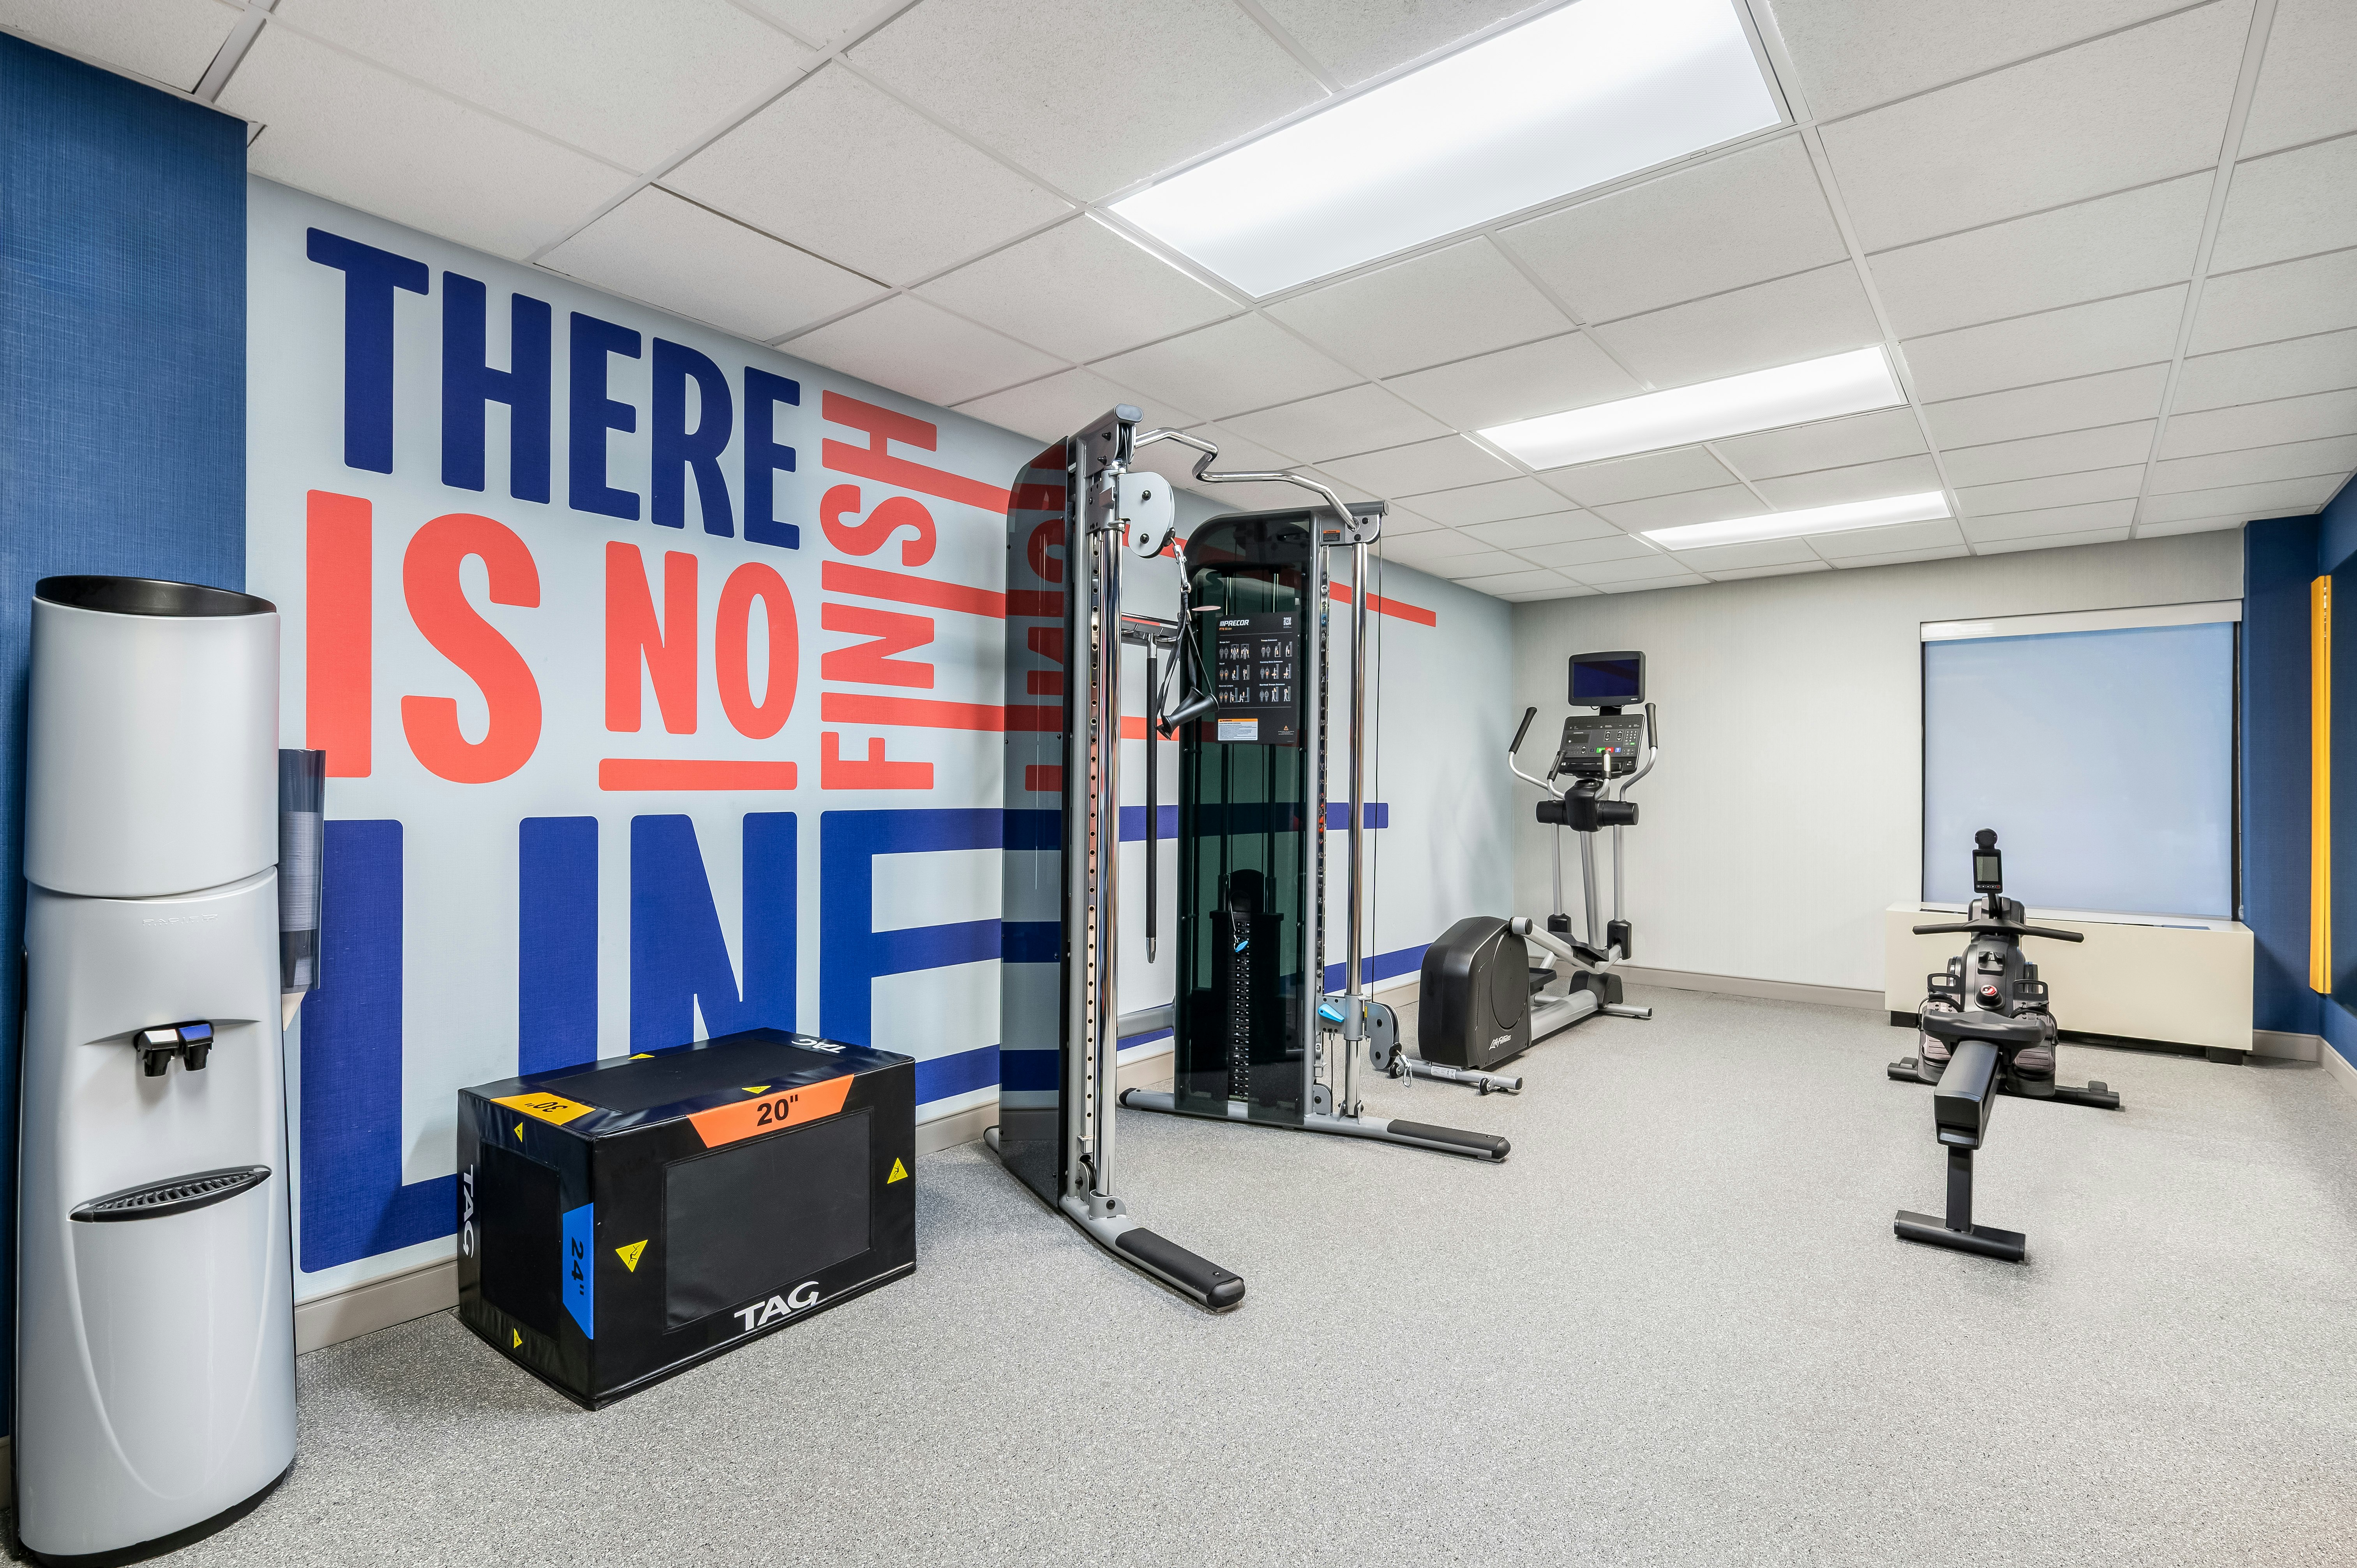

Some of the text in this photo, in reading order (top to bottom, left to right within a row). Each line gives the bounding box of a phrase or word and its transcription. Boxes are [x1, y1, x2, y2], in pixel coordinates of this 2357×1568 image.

[307, 227, 800, 550] THERE
[819, 390, 938, 790] FINISH
[306, 489, 542, 785] IS
[605, 540, 799, 740] NO
[302, 810, 1006, 1273] LINE
[791, 1037, 846, 1054] TAG
[524, 1102, 568, 1112] 30"
[757, 1094, 798, 1126] 20"
[462, 1164, 475, 1259] TAG
[571, 1236, 584, 1296] 24"
[734, 1281, 819, 1331] TAG
